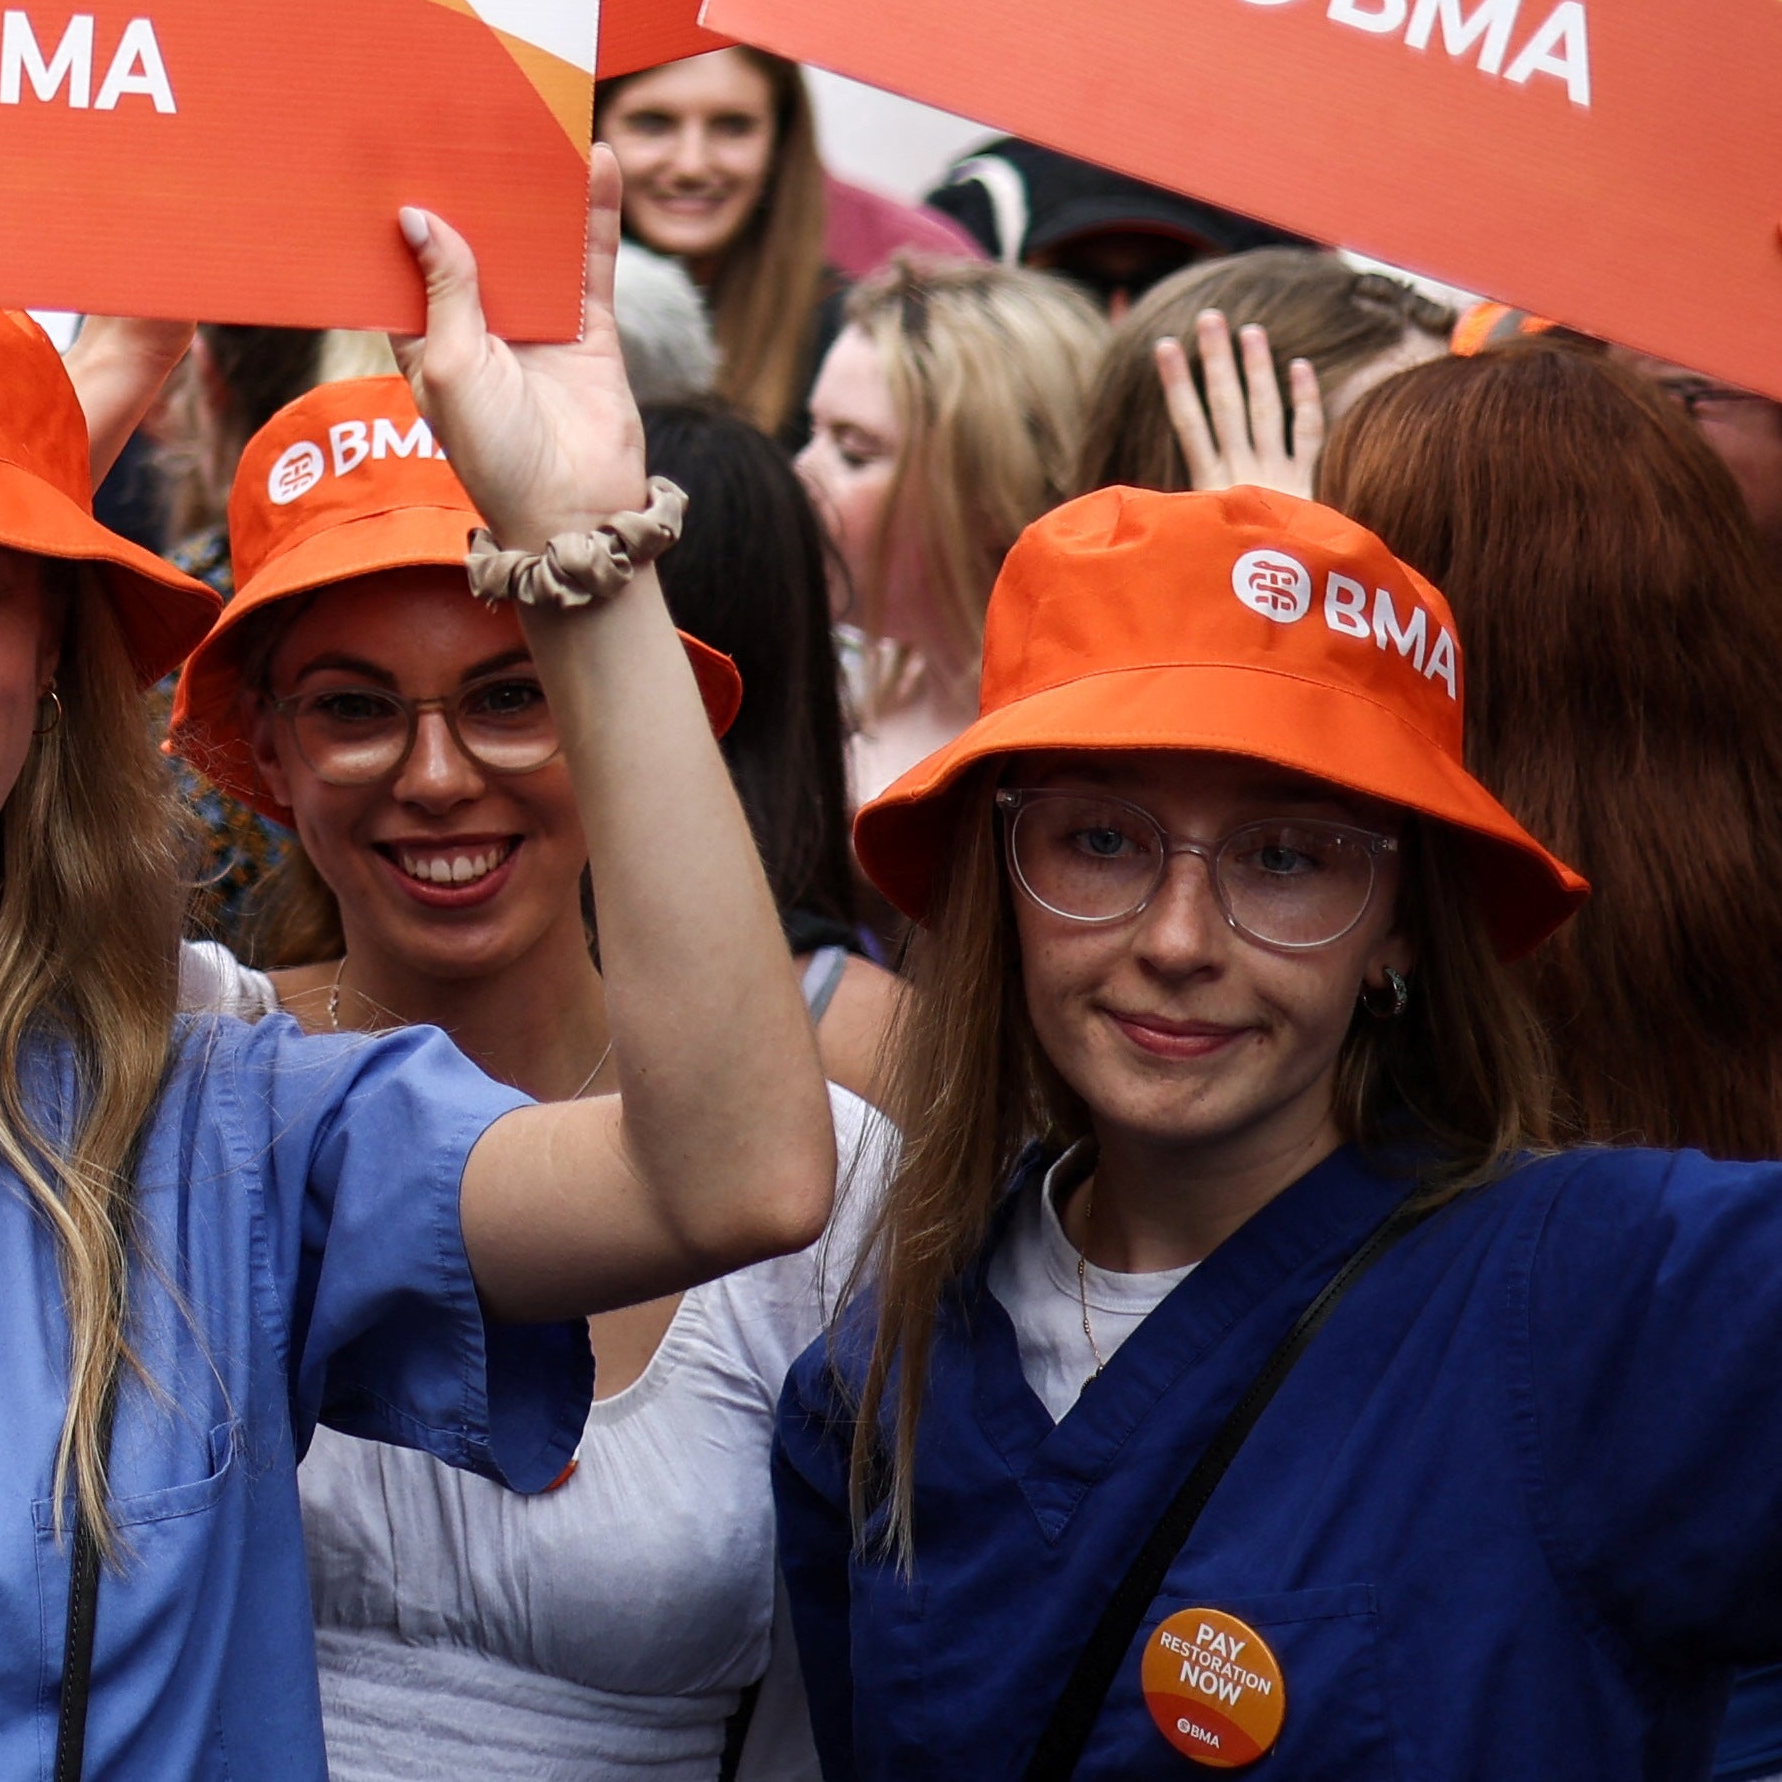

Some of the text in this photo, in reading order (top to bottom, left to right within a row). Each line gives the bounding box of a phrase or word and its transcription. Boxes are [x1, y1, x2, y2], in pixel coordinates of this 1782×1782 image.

[329, 417, 447, 478] BM
[1323, 571, 1458, 701] BMA
[1161, 1632, 1271, 1695] RESTORATION
[1196, 1624, 1245, 1661] PAY
[1180, 1661, 1242, 1705] NOW
[1191, 1726, 1220, 1748] BMA
